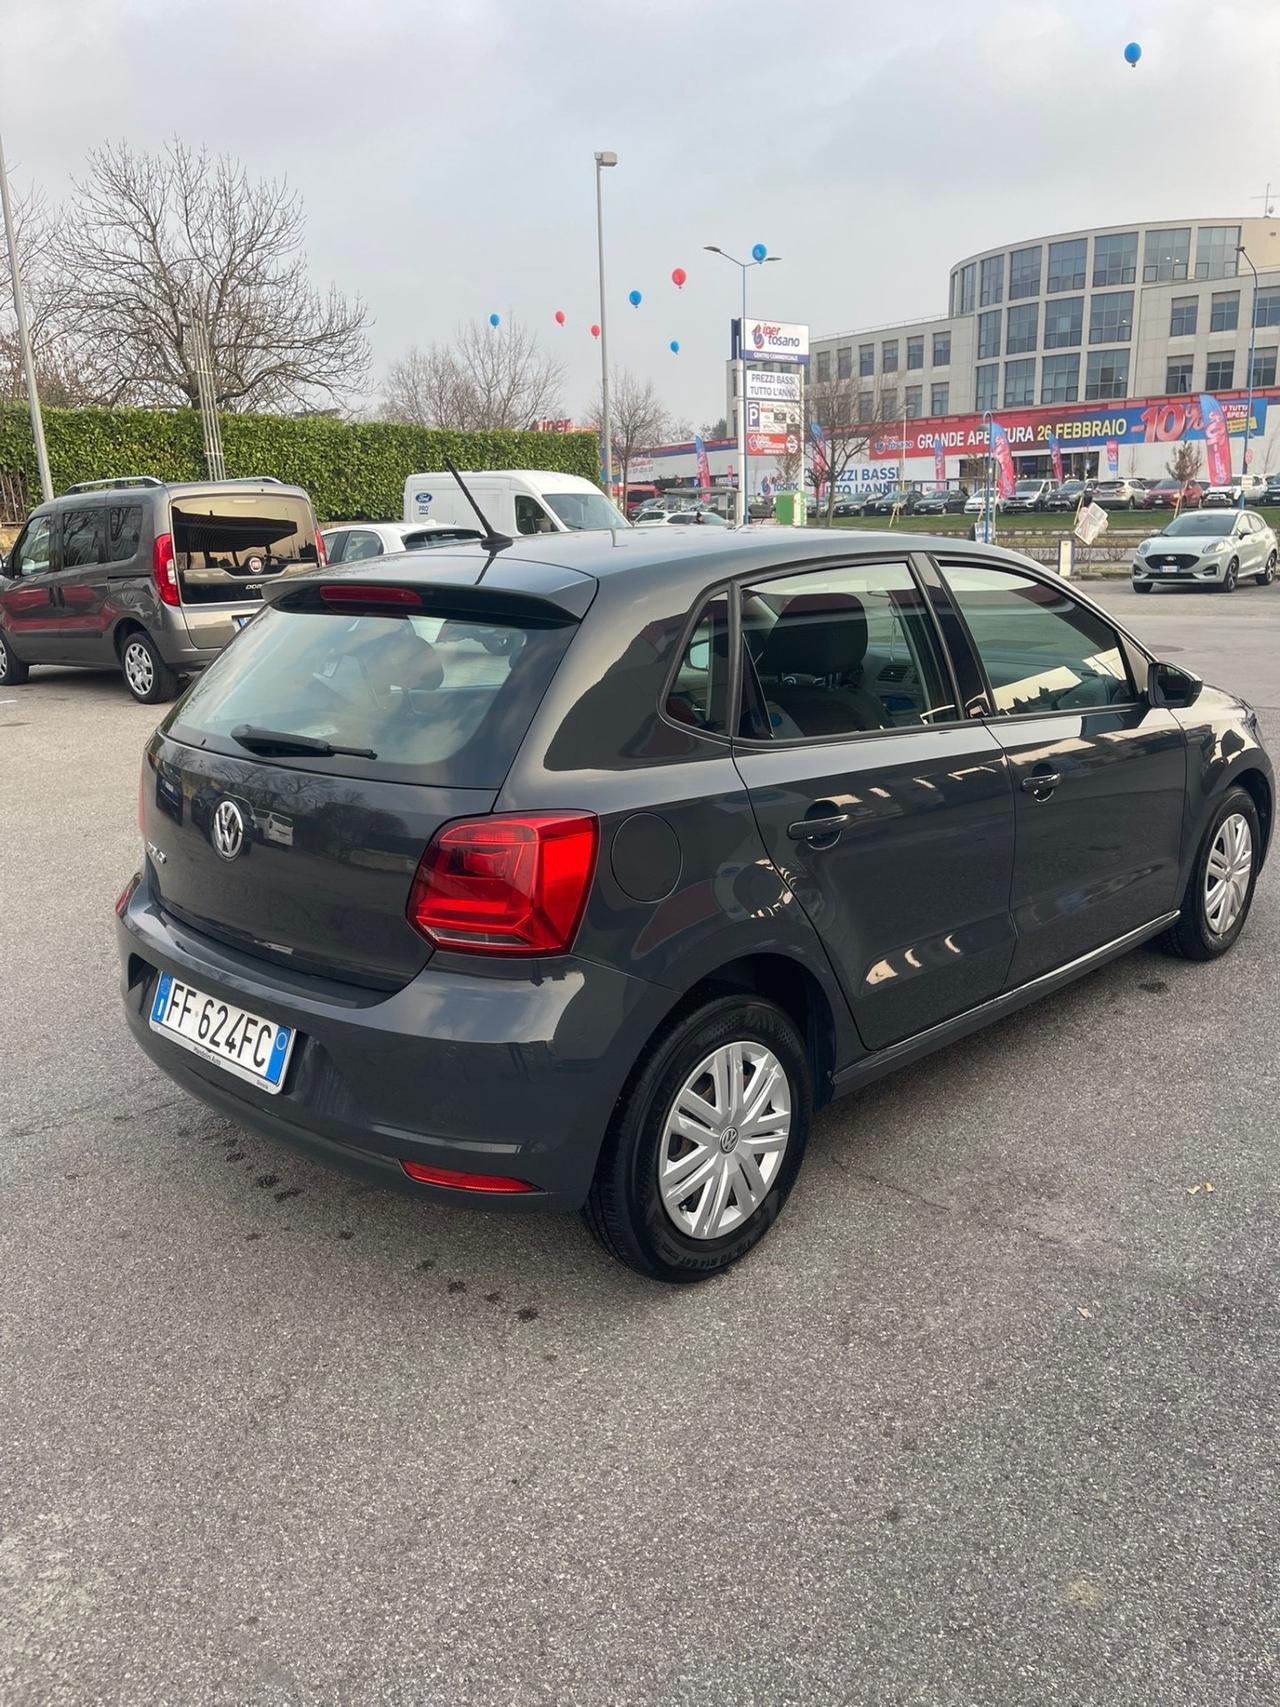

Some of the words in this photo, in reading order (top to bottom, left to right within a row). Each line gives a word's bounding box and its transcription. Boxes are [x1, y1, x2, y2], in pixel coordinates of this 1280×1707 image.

[763, 323, 781, 336] iper
[768, 335, 800, 348] tosano
[751, 373, 776, 384] PREZZI
[750, 386, 773, 396] TUTTO
[967, 425, 1034, 446] APEURA
[1055, 418, 1127, 440] FEBBRAIO
[862, 467, 899, 481] BASSI
